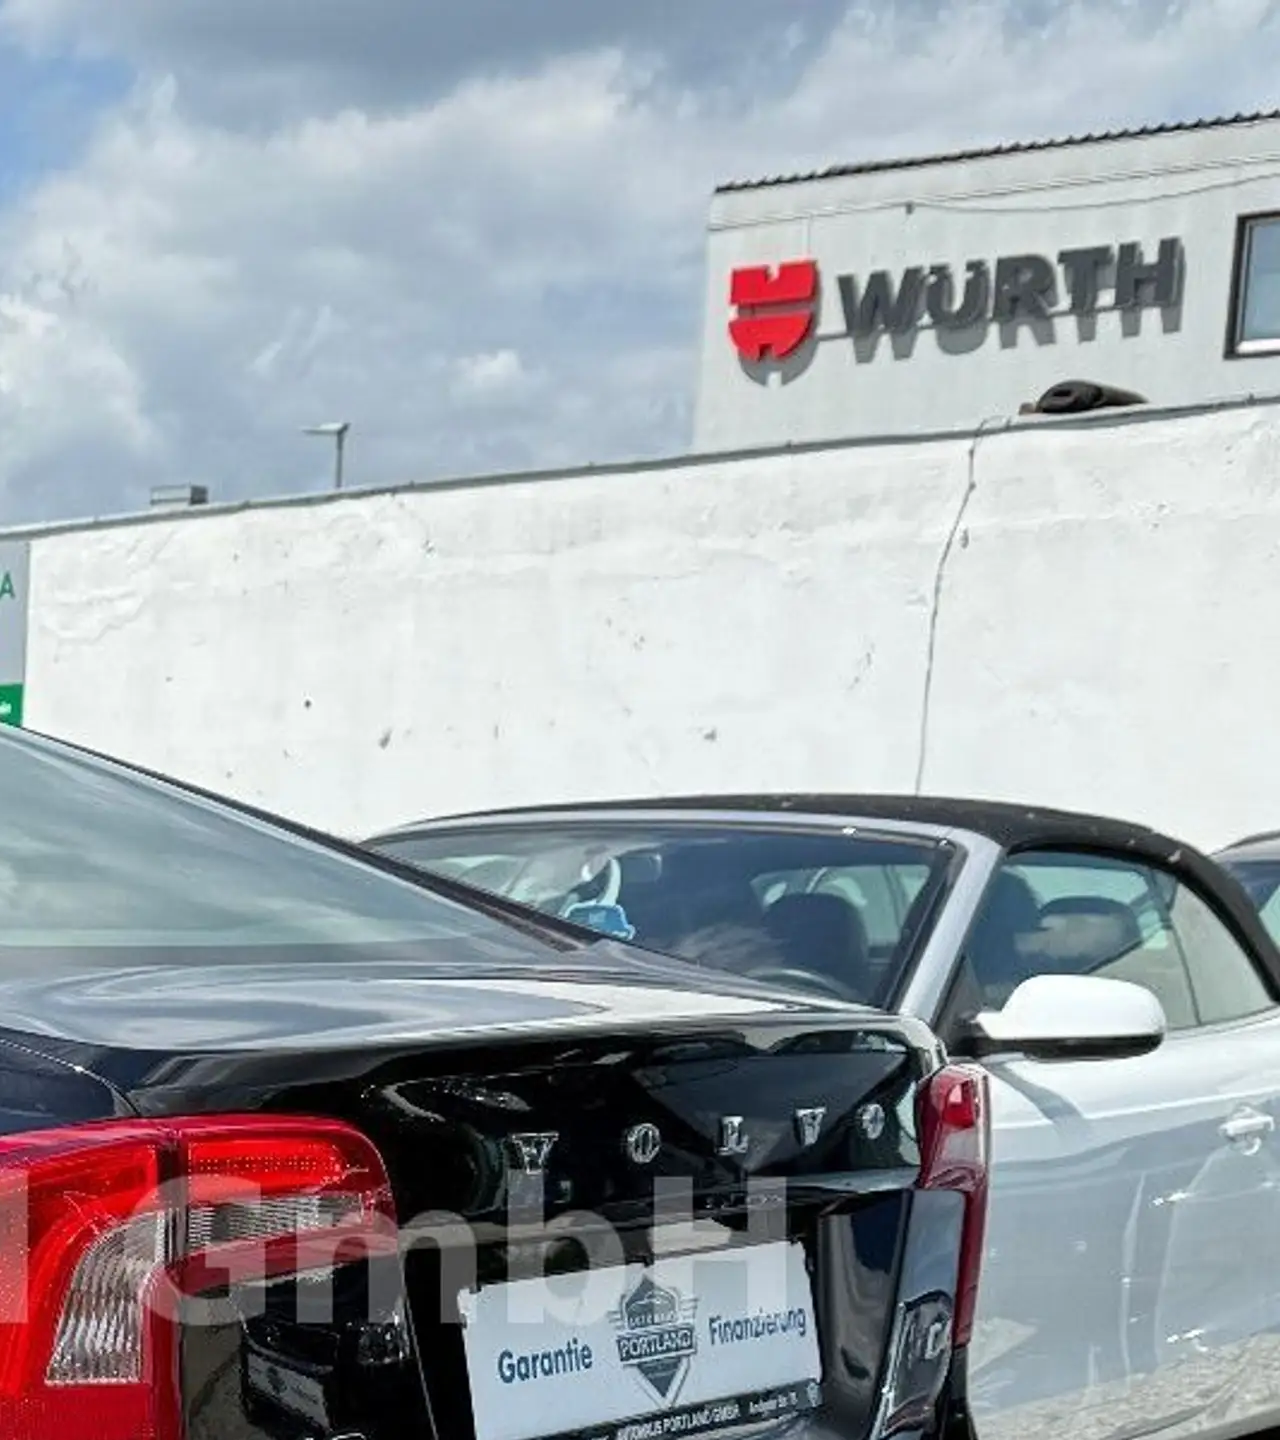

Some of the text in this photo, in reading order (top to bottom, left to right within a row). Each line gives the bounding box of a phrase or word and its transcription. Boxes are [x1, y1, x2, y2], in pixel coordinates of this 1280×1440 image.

[512, 1102, 886, 1175] VOLVO
[618, 1329, 692, 1362] PORTLAND
[708, 1306, 807, 1346] Finanzierung
[497, 1337, 593, 1385] Garantie
